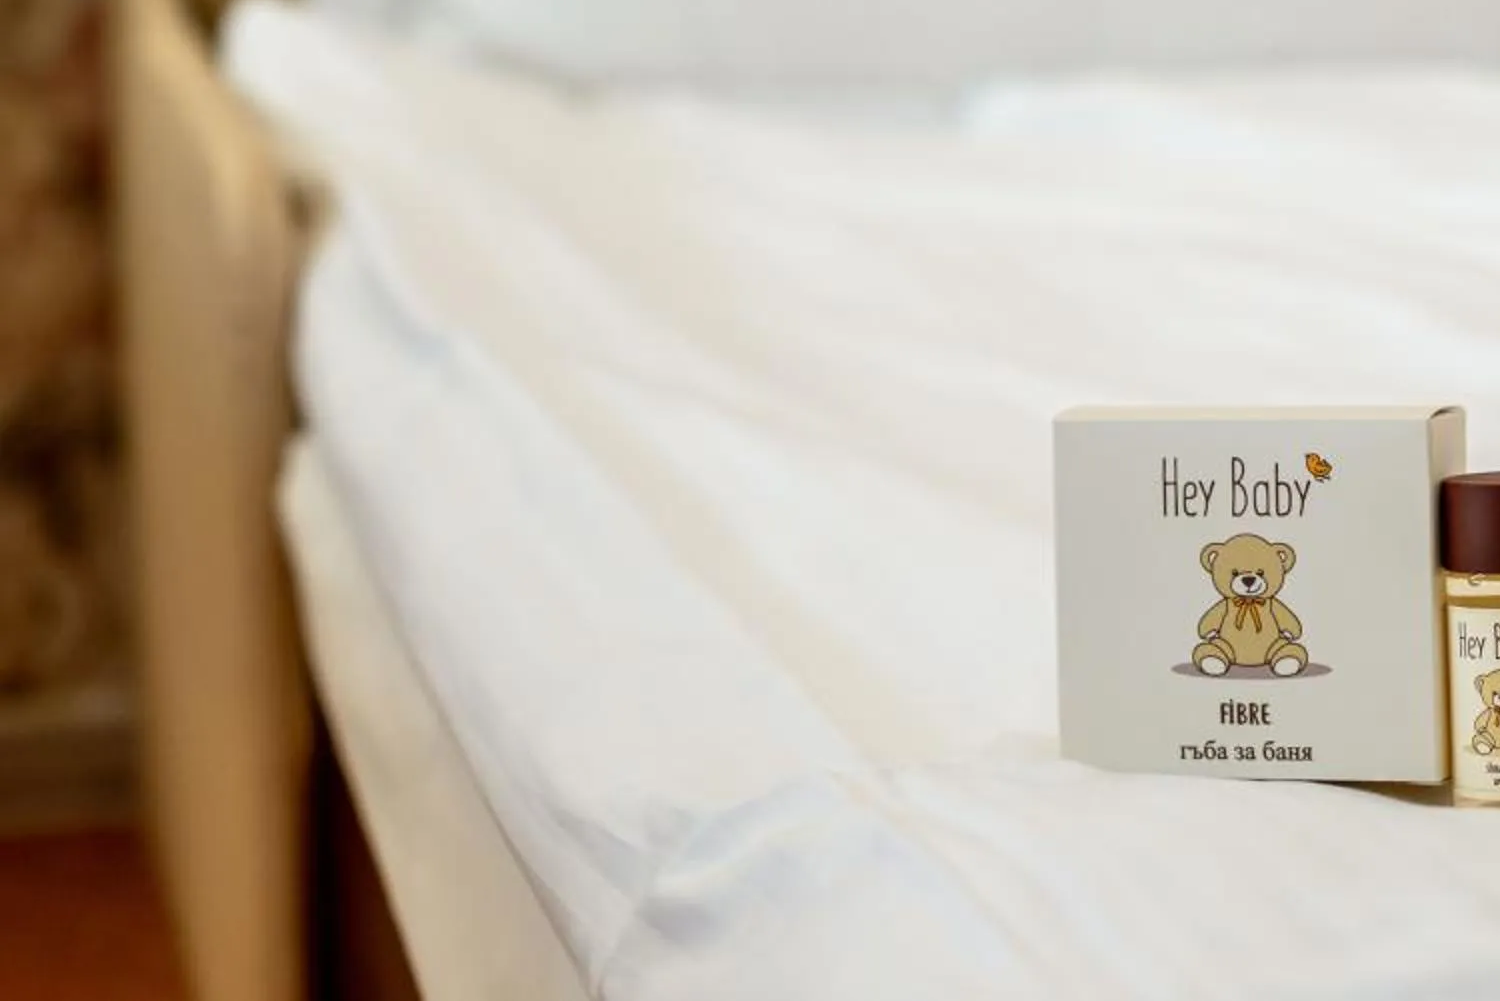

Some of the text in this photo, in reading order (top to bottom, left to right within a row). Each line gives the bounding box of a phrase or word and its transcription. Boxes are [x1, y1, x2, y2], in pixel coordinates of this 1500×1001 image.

[1162, 456, 1312, 517] Hey Baby
[1458, 621, 1487, 659] Hey
[1180, 739, 1313, 761] гъба за баня
